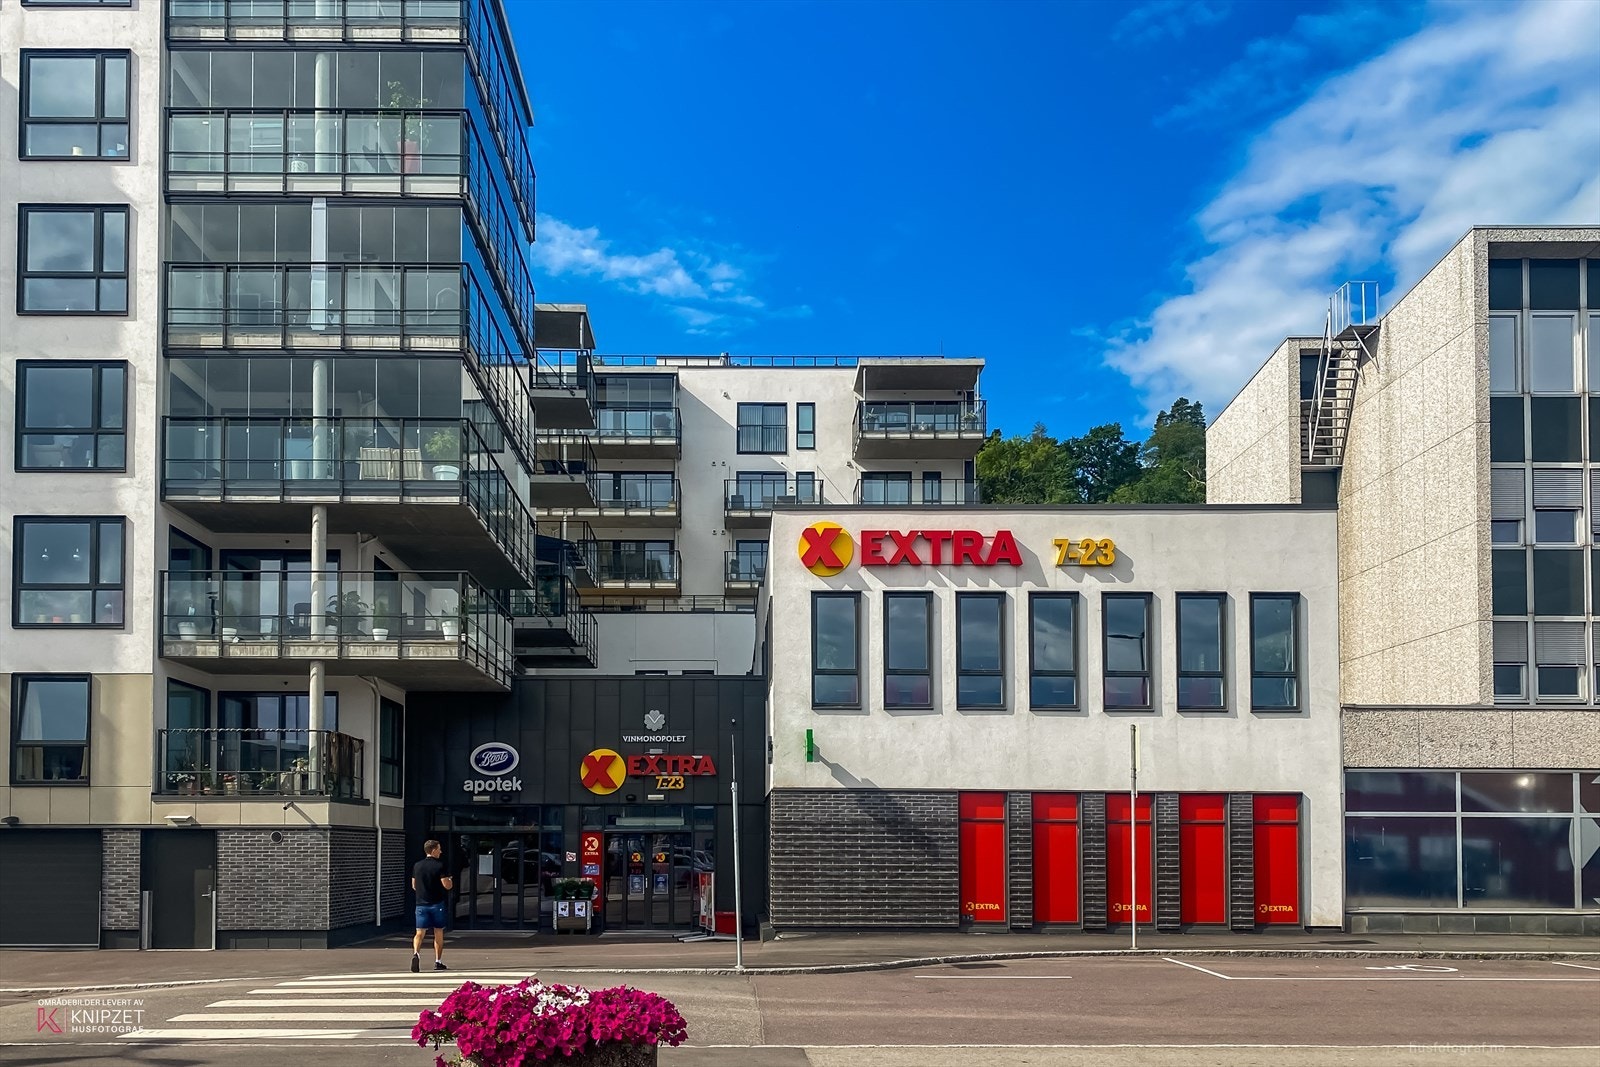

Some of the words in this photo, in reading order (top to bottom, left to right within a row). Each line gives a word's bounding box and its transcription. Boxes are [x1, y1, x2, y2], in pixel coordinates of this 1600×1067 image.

[860, 529, 1023, 567] EXTRA
[1053, 538, 1116, 567] 7-23
[622, 735, 687, 743] VINMONOPOLET
[479, 751, 509, 767] Boots
[627, 755, 717, 776] EXTRA
[463, 776, 522, 794] apotek
[655, 775, 685, 790] 7-23
